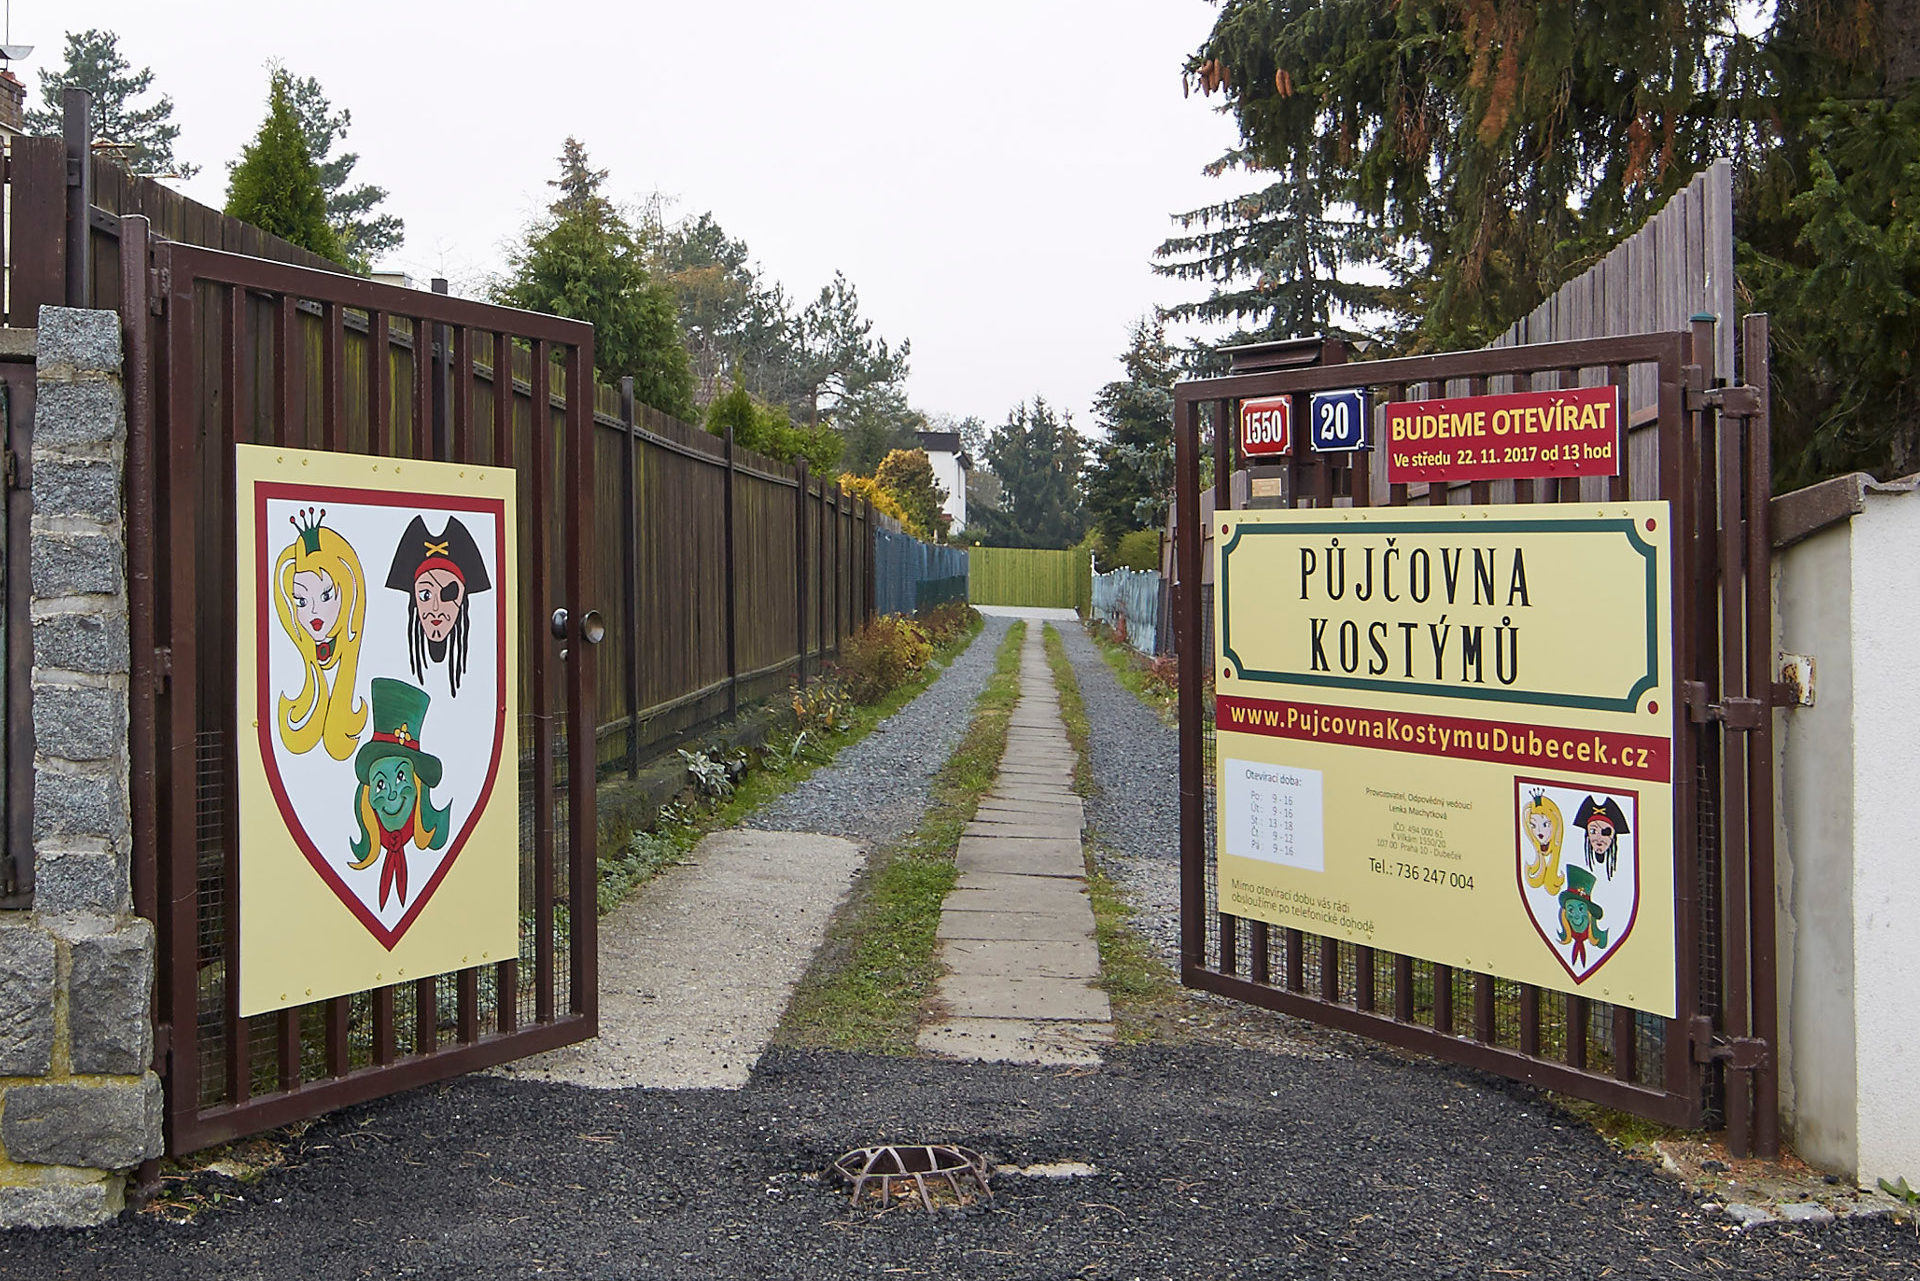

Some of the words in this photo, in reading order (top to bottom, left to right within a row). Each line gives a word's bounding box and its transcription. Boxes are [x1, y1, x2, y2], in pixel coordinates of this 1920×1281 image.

[1245, 410, 1282, 444] 1550
[1320, 401, 1349, 440] 20
[1391, 411, 1486, 441] BUDEME
[1492, 399, 1610, 436] OTEVÍRAT
[1393, 453, 1409, 467] Ve
[1411, 451, 1451, 467] středu
[1457, 450, 1477, 465] 22.
[1480, 449, 1500, 464] 11.
[1504, 446, 1537, 462] 2017
[1541, 444, 1559, 461] od
[1562, 444, 1580, 460] 13
[1583, 442, 1612, 459] hod
[1299, 537, 1534, 607] PŮJČOVNA
[1309, 614, 1520, 685] KOSTÝMŮ
[1230, 705, 1650, 769] www.PujcovnaKostymuDubecek.cz
[1388, 804, 1407, 815] Lenka
[1368, 857, 1393, 876] Tel.:
[1396, 862, 1420, 880] 736
[1422, 867, 1446, 885] 247
[1449, 872, 1474, 890] 004
[1231, 878, 1255, 893] Mimo
[1293, 890, 1315, 907] dobu
[1317, 896, 1331, 910] vás
[1333, 900, 1350, 914] rádi
[1278, 903, 1290, 915] po
[1291, 905, 1338, 924] telefonické
[1340, 915, 1375, 933] dohodě
